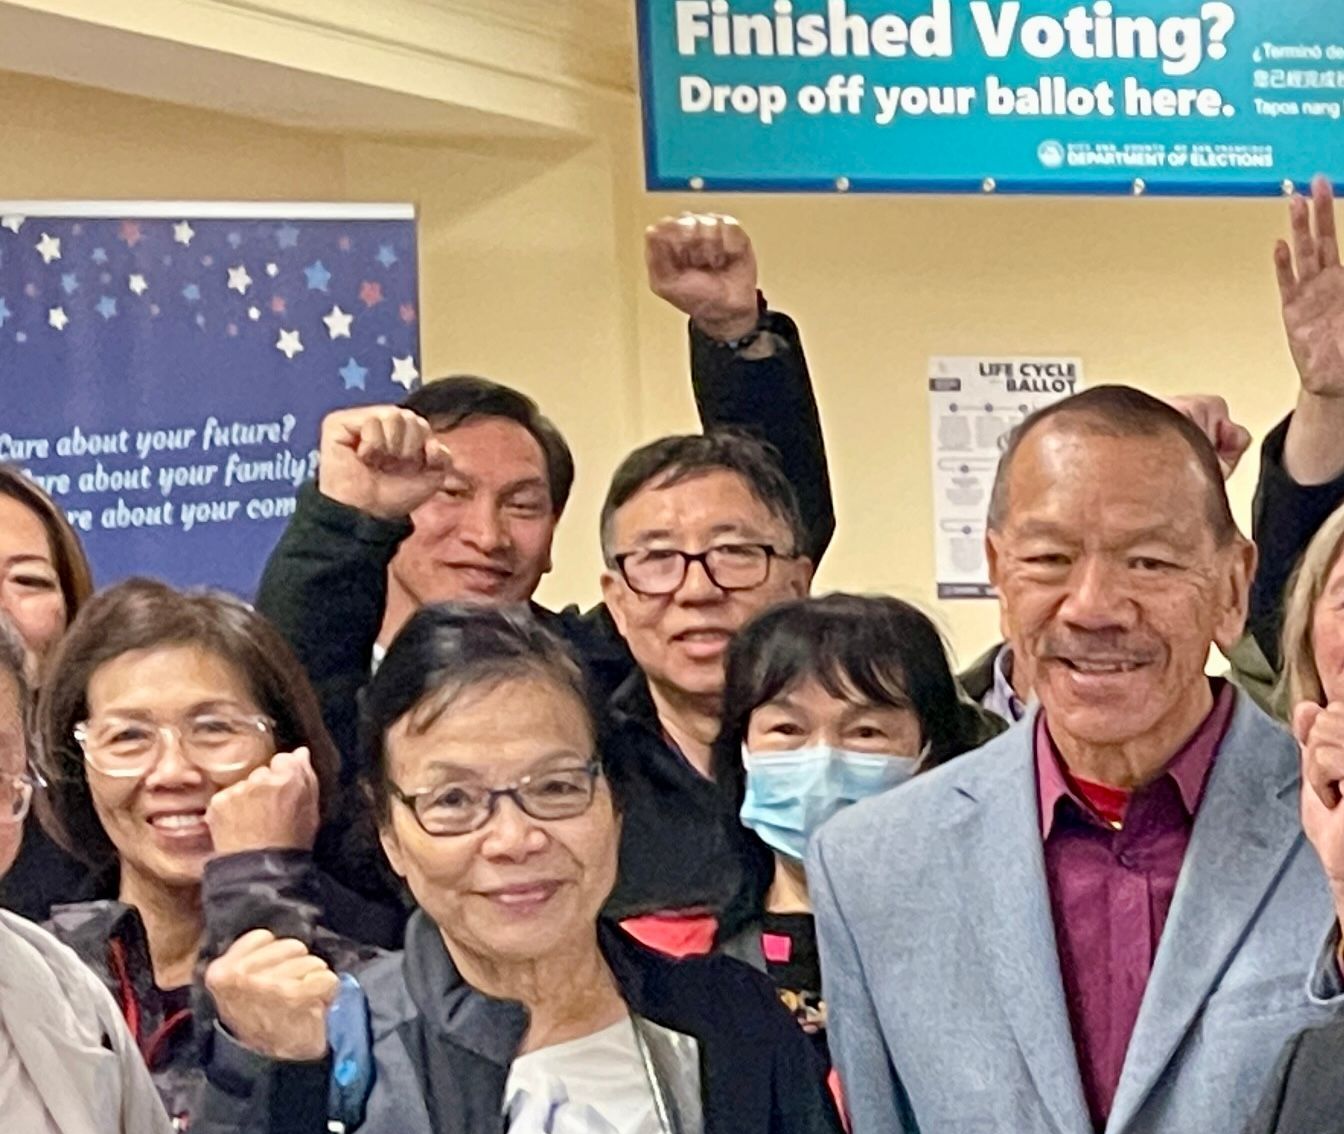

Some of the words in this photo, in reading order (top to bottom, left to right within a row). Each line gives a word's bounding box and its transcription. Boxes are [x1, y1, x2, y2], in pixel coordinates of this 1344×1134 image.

[675, 0, 952, 57] Finished
[969, 0, 1236, 75] Voting?
[680, 76, 787, 124] Drop
[798, 74, 864, 114] off
[873, 86, 976, 124] your
[986, 75, 1114, 115] ballot
[1125, 77, 1236, 117] here.
[1067, 151, 1164, 166] DEPARTMENT
[1168, 151, 1187, 166] OF
[1191, 151, 1273, 167] ELECTIONS
[979, 363, 1013, 377] LIFE
[1020, 363, 1075, 377] CYCLE
[1006, 379, 1075, 395] BALLOT
[56, 425, 130, 456] about
[136, 429, 196, 460] your
[202, 413, 297, 450] future?
[78, 459, 152, 493] about
[159, 464, 218, 497] your
[224, 449, 320, 488] family?
[101, 497, 173, 529] about
[180, 500, 240, 532] your
